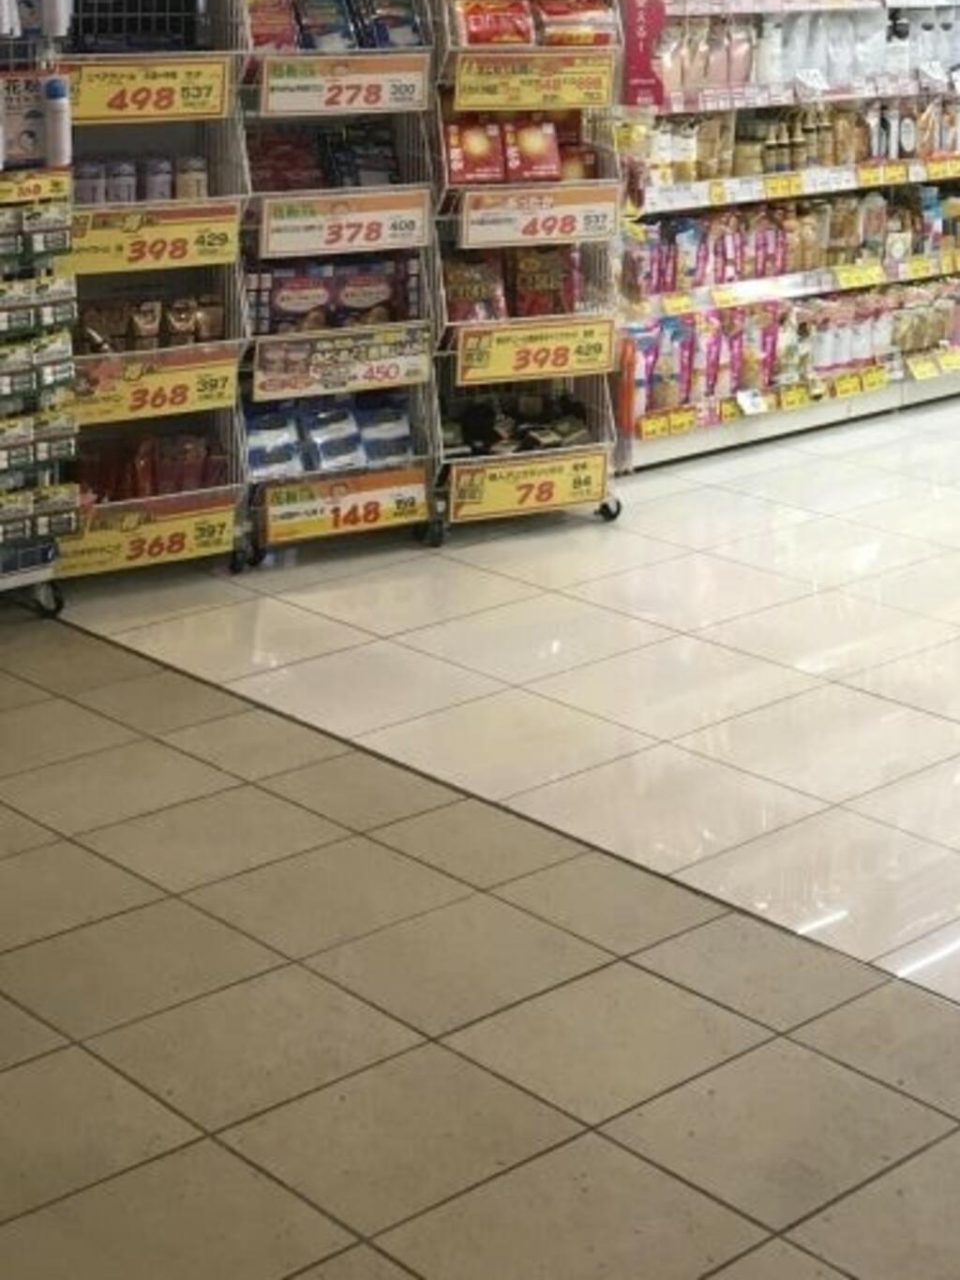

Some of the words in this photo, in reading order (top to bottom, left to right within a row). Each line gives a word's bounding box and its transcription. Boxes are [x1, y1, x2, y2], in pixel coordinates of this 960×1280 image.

[106, 85, 176, 111] 498
[324, 83, 383, 107] 278
[324, 222, 383, 246] 378
[521, 214, 577, 236] 498
[127, 237, 189, 263] 398
[194, 231, 229, 247] 429
[512, 346, 570, 372] 398
[129, 383, 190, 413] 368
[195, 376, 229, 392] 397
[516, 480, 555, 505] 78
[330, 501, 381, 529] 148
[126, 531, 187, 561] 368
[193, 522, 227, 540] 397
